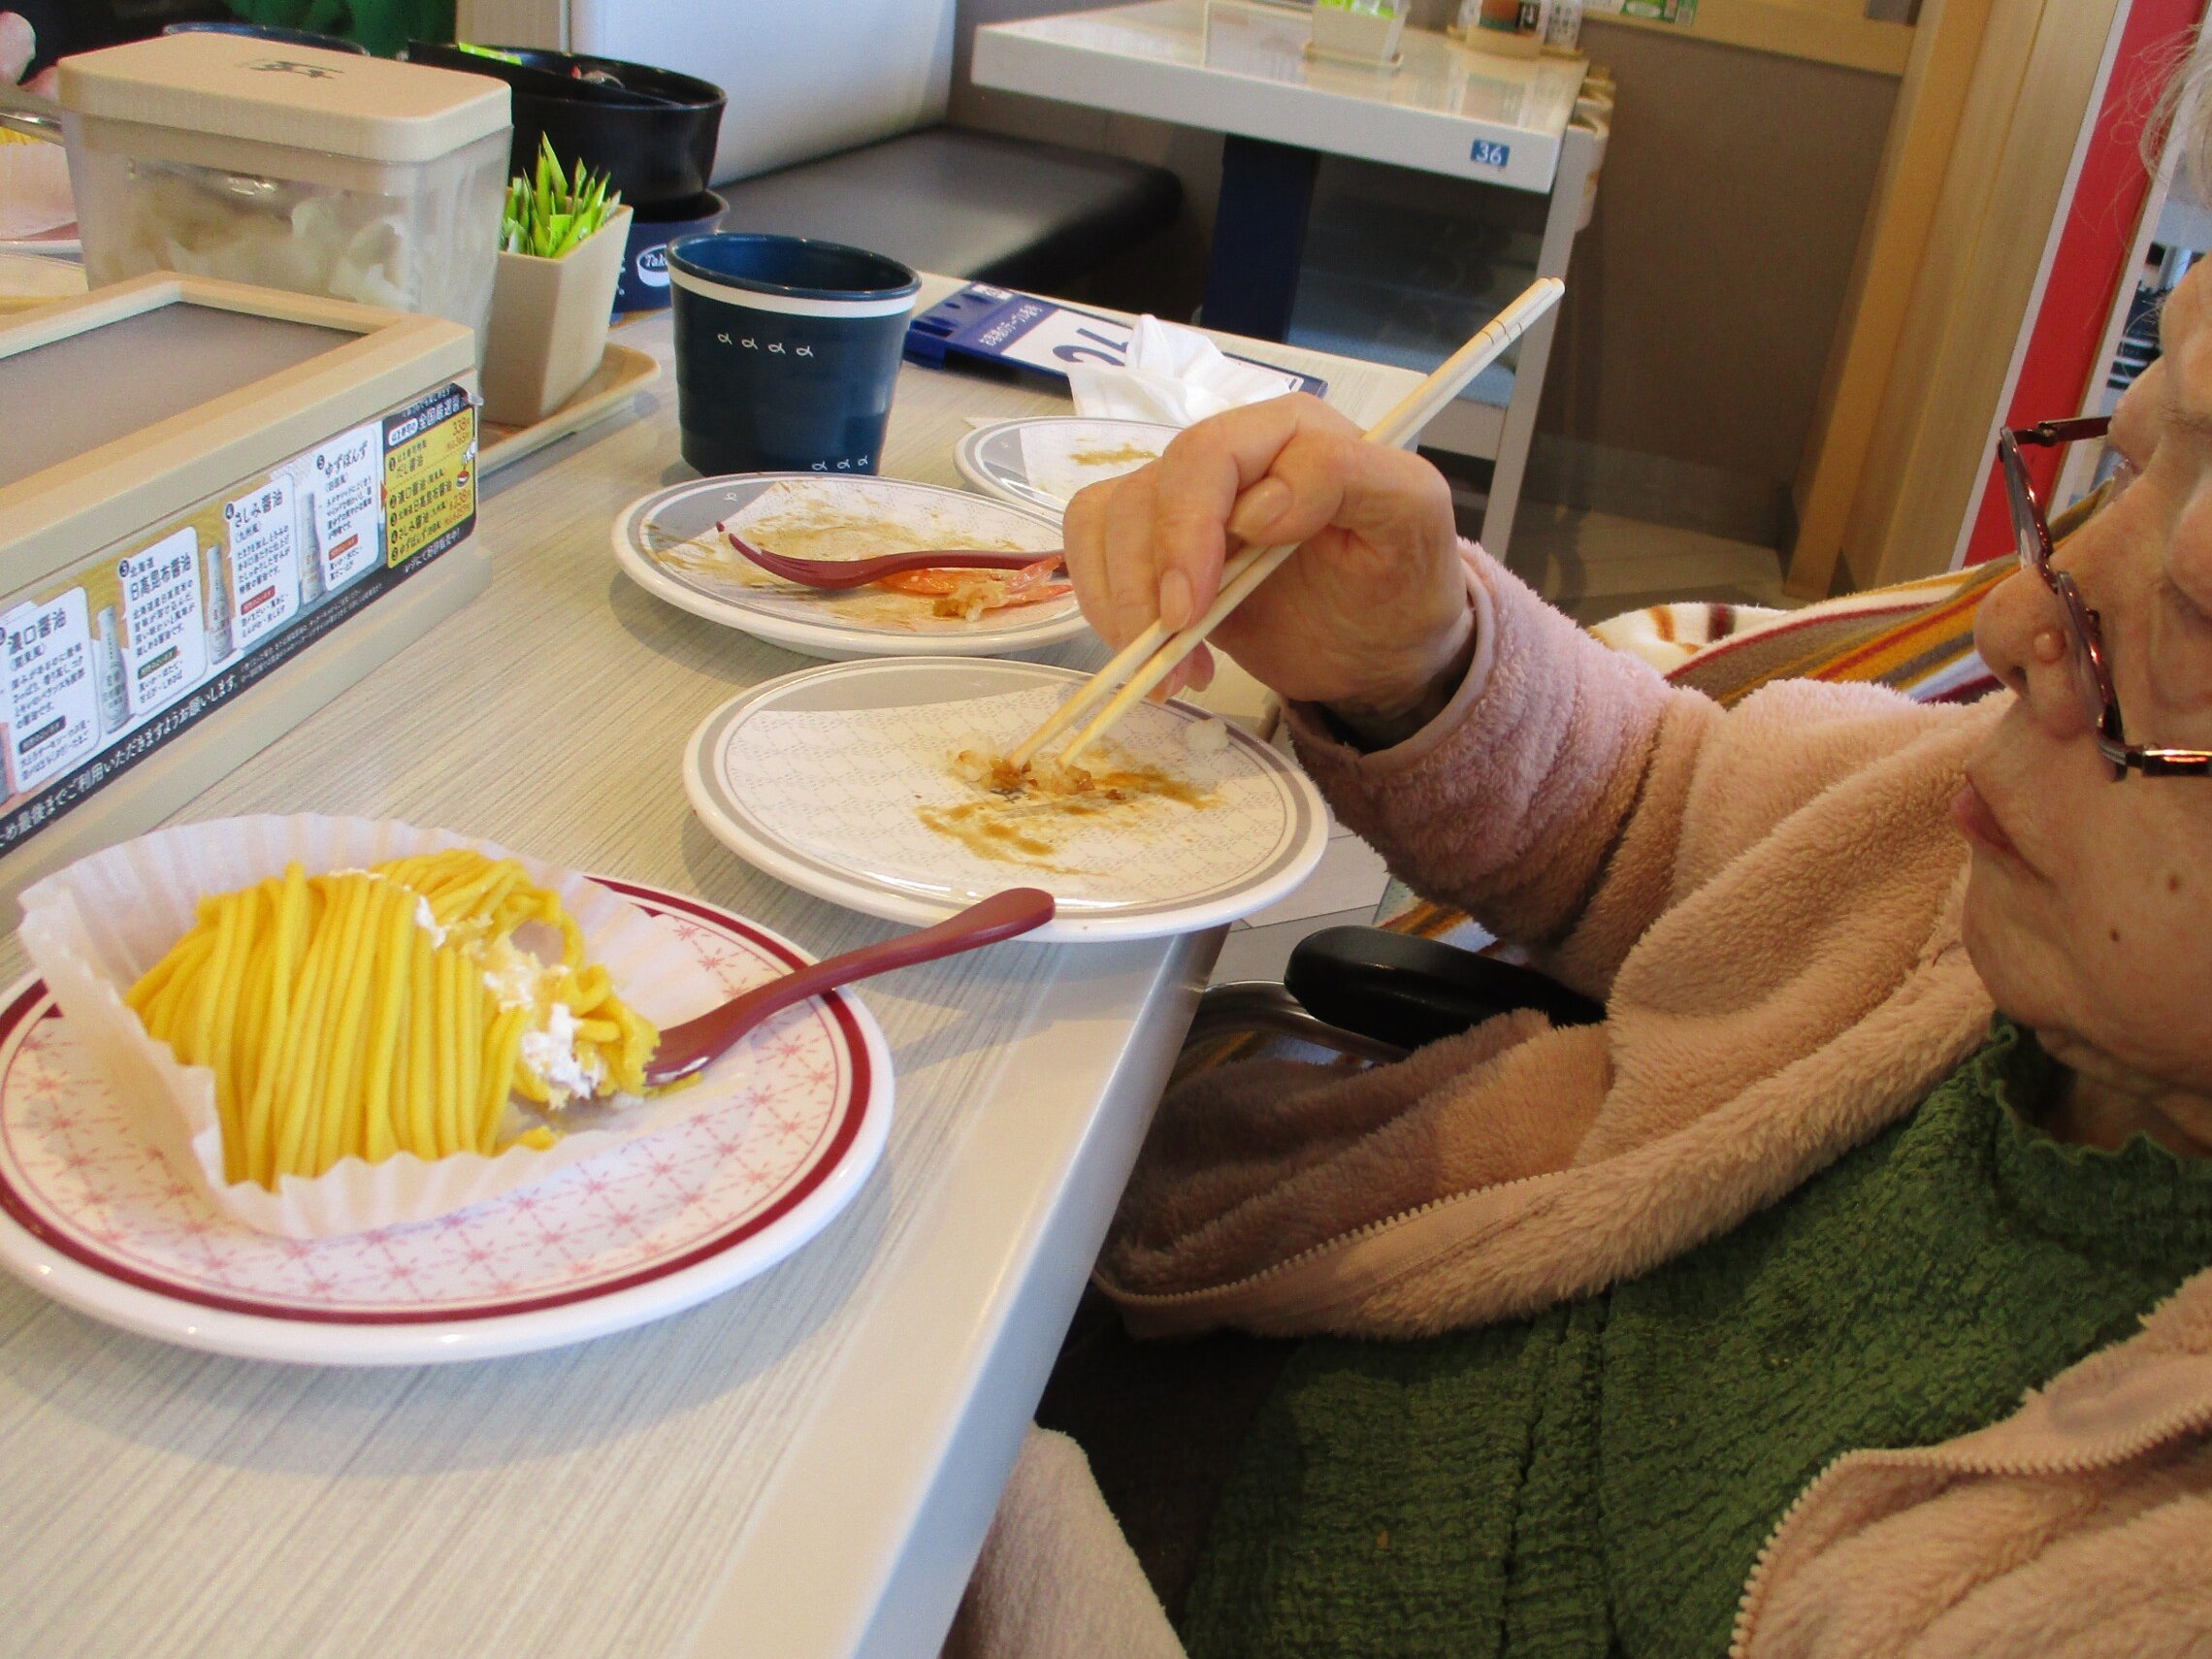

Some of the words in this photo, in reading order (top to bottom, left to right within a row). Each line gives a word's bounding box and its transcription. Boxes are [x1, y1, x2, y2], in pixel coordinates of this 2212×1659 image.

[1476, 140, 1502, 165] 36
[235, 489, 283, 528] さしみ醤油
[130, 557, 154, 577] 北海道
[131, 552, 192, 601] 日高昆布醤油
[8, 607, 67, 656] 濃口醤油
